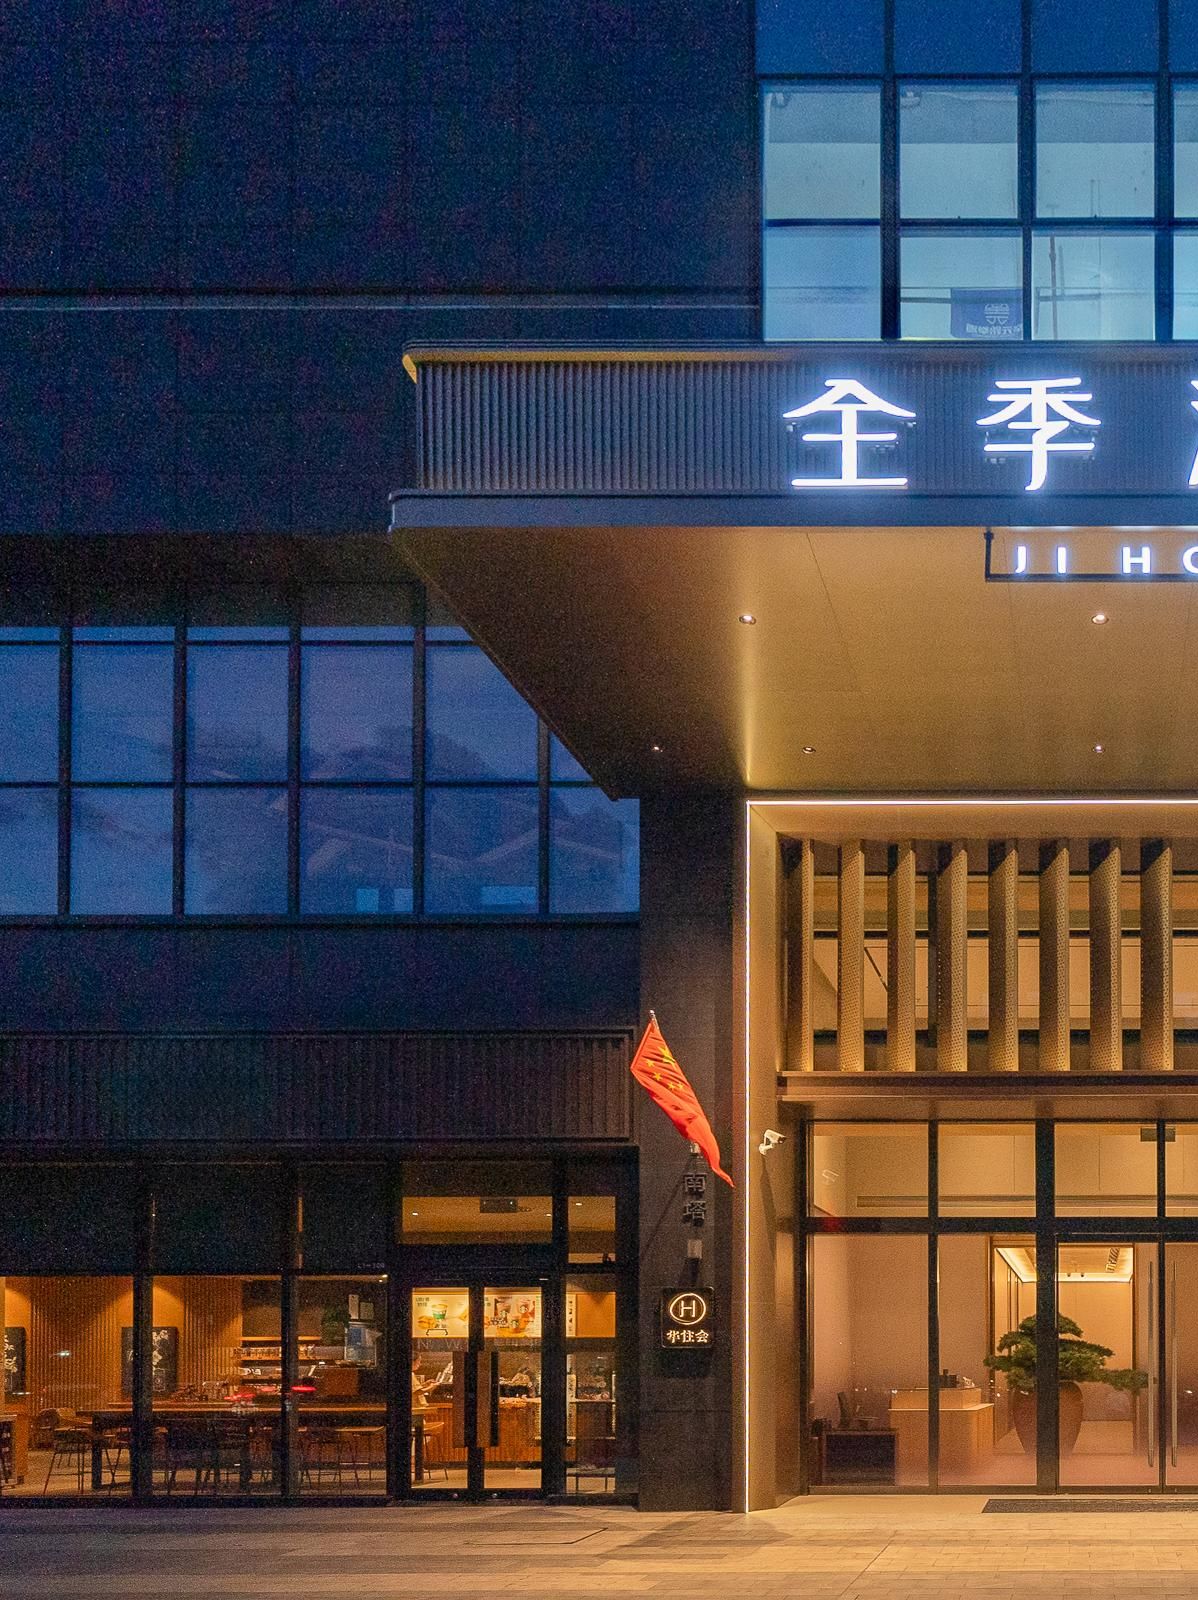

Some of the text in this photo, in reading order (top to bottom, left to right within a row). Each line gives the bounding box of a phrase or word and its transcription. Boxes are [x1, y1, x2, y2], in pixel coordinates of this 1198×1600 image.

[1015, 546, 1067, 574] JI
[666, 1329, 709, 1344] 华住会
